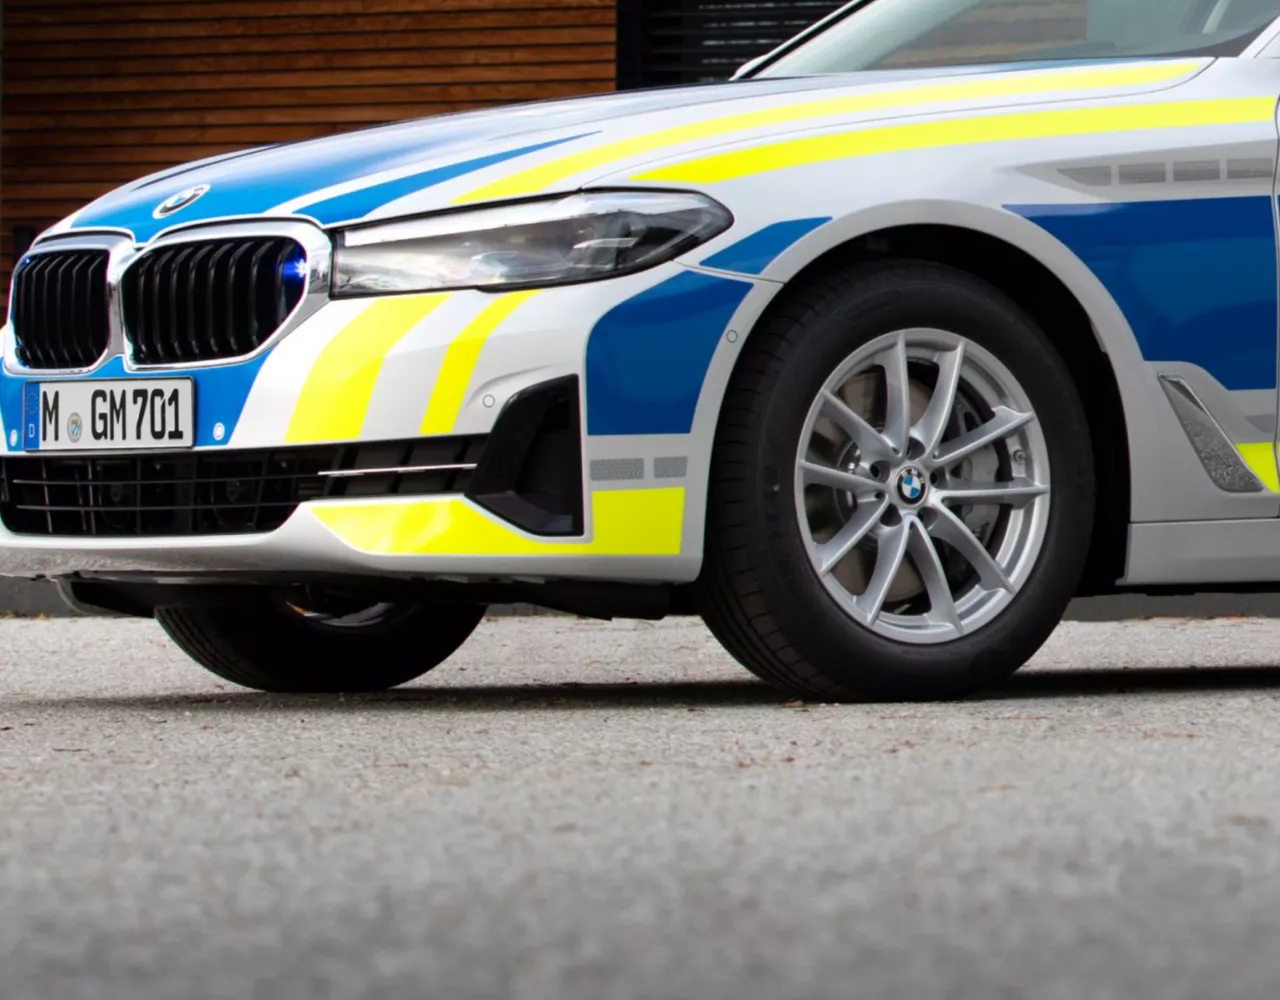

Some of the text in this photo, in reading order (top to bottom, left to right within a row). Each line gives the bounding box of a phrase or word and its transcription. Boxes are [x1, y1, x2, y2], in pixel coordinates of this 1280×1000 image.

[28, 423, 36, 439] D
[42, 388, 184, 442] M GM 701
